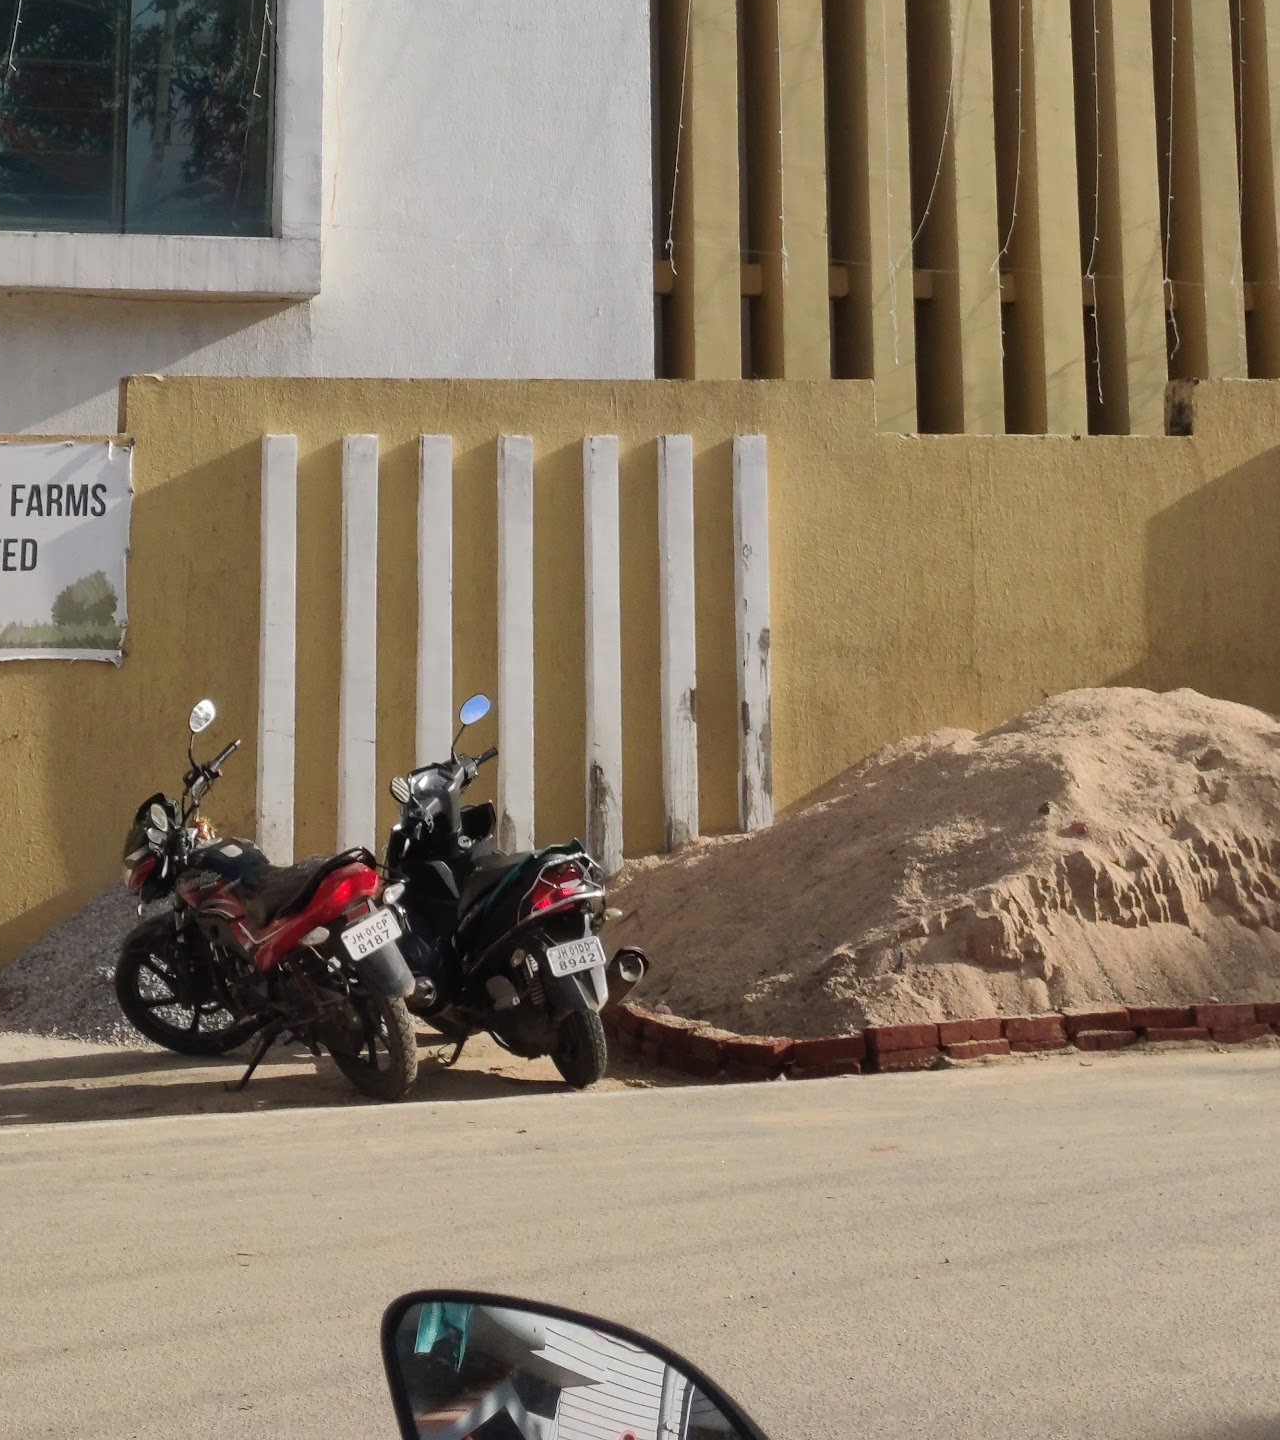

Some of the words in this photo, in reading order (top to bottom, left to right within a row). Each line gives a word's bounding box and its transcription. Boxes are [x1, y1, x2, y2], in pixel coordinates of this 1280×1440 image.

[10, 483, 108, 517] FARMS
[358, 930, 391, 954] 8187
[559, 953, 597, 970] 8942
